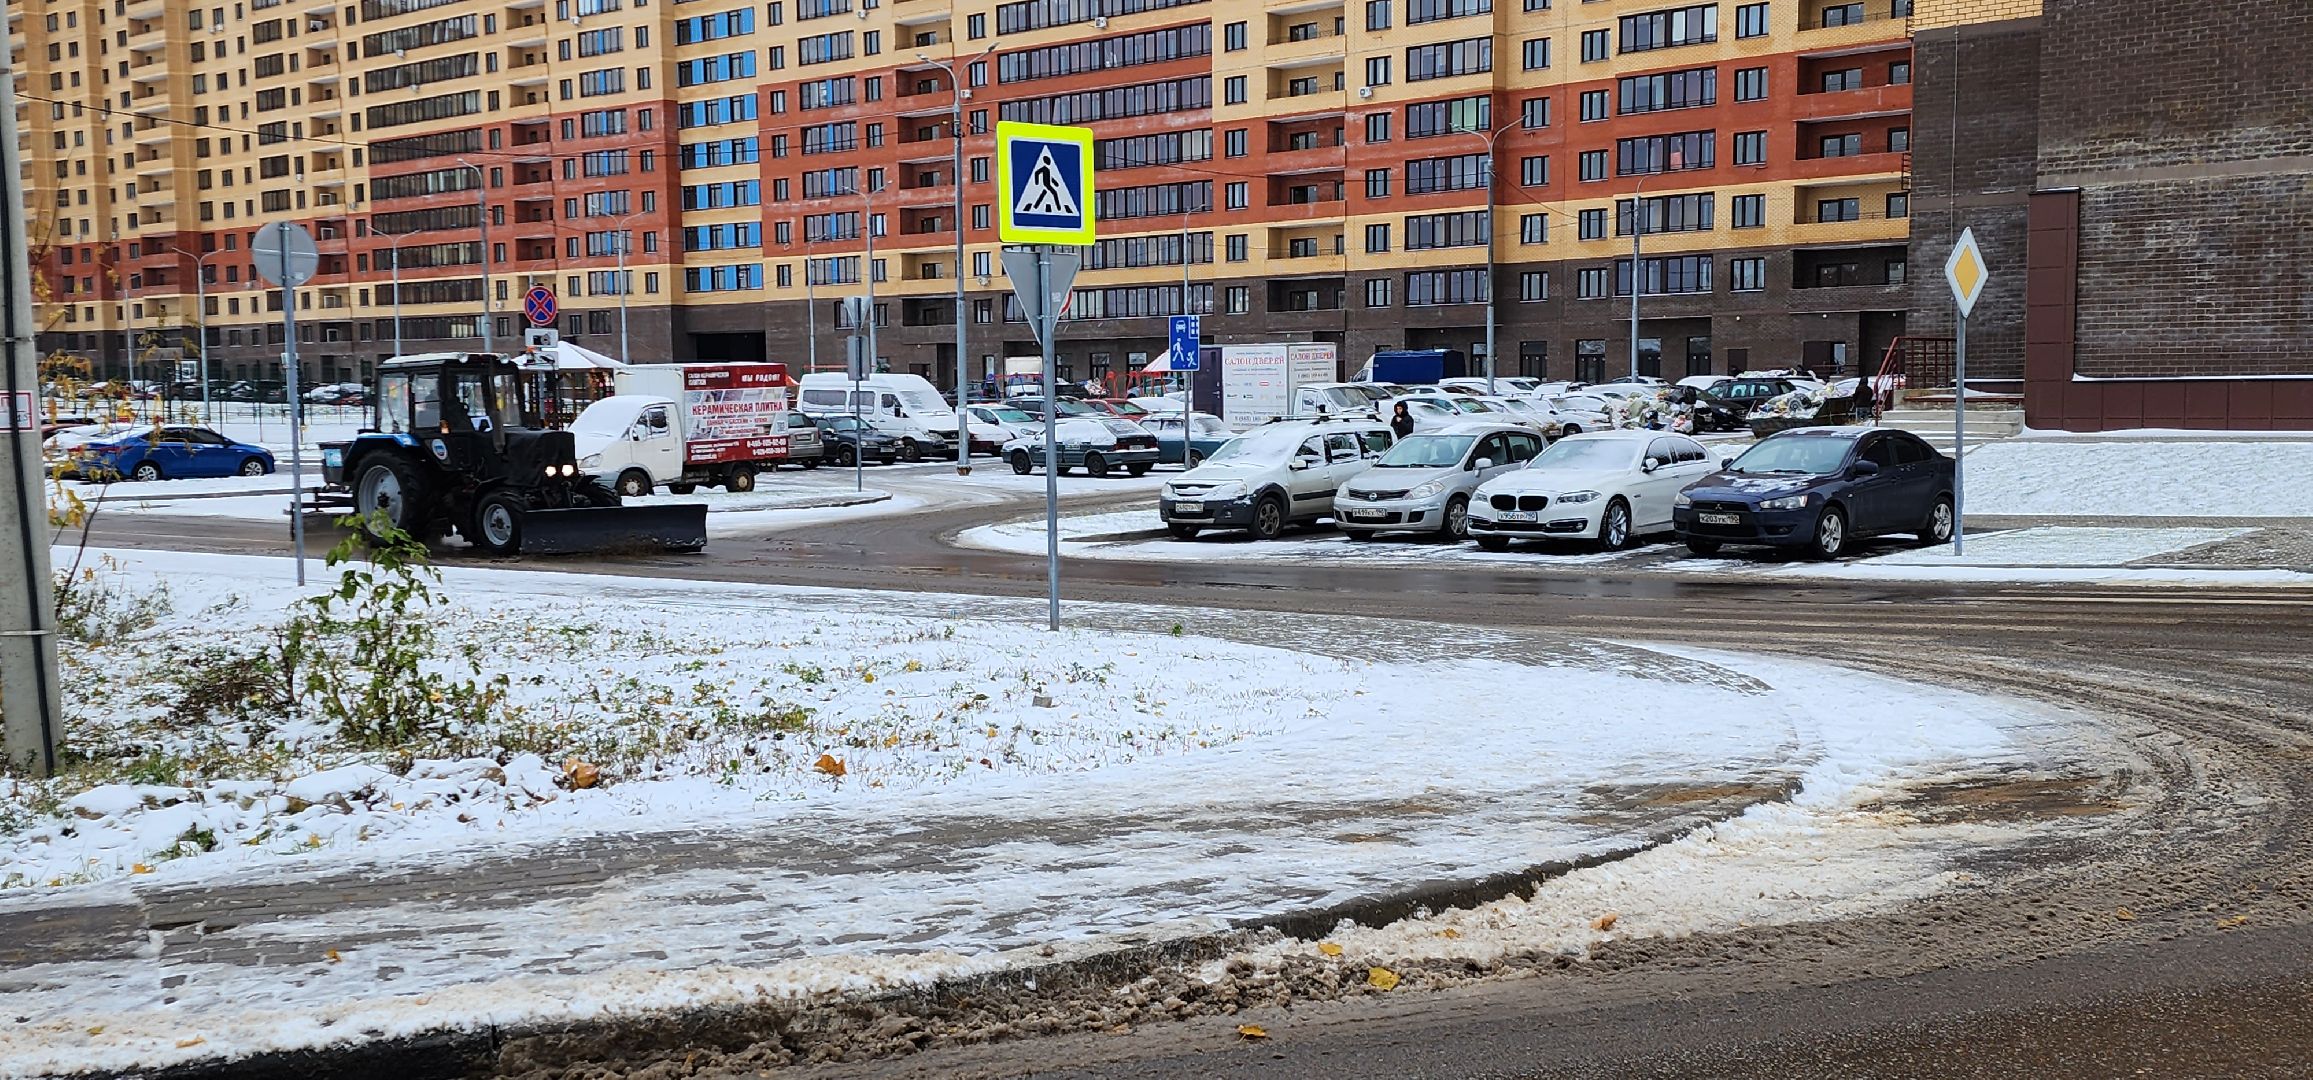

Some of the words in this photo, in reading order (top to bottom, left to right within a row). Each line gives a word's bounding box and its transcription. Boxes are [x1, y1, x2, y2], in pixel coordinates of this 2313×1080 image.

[1291, 352, 1310, 360] САЛОН
[1312, 351, 1334, 360] ДВЕРЕЙ
[1225, 357, 1250, 365] САЛОН
[1252, 356, 1284, 365] ДВЕРЕЙ
[692, 403, 753, 415] КЕРАМИЧЕСКАЯ
[755, 401, 783, 412] ПЛИТКА
